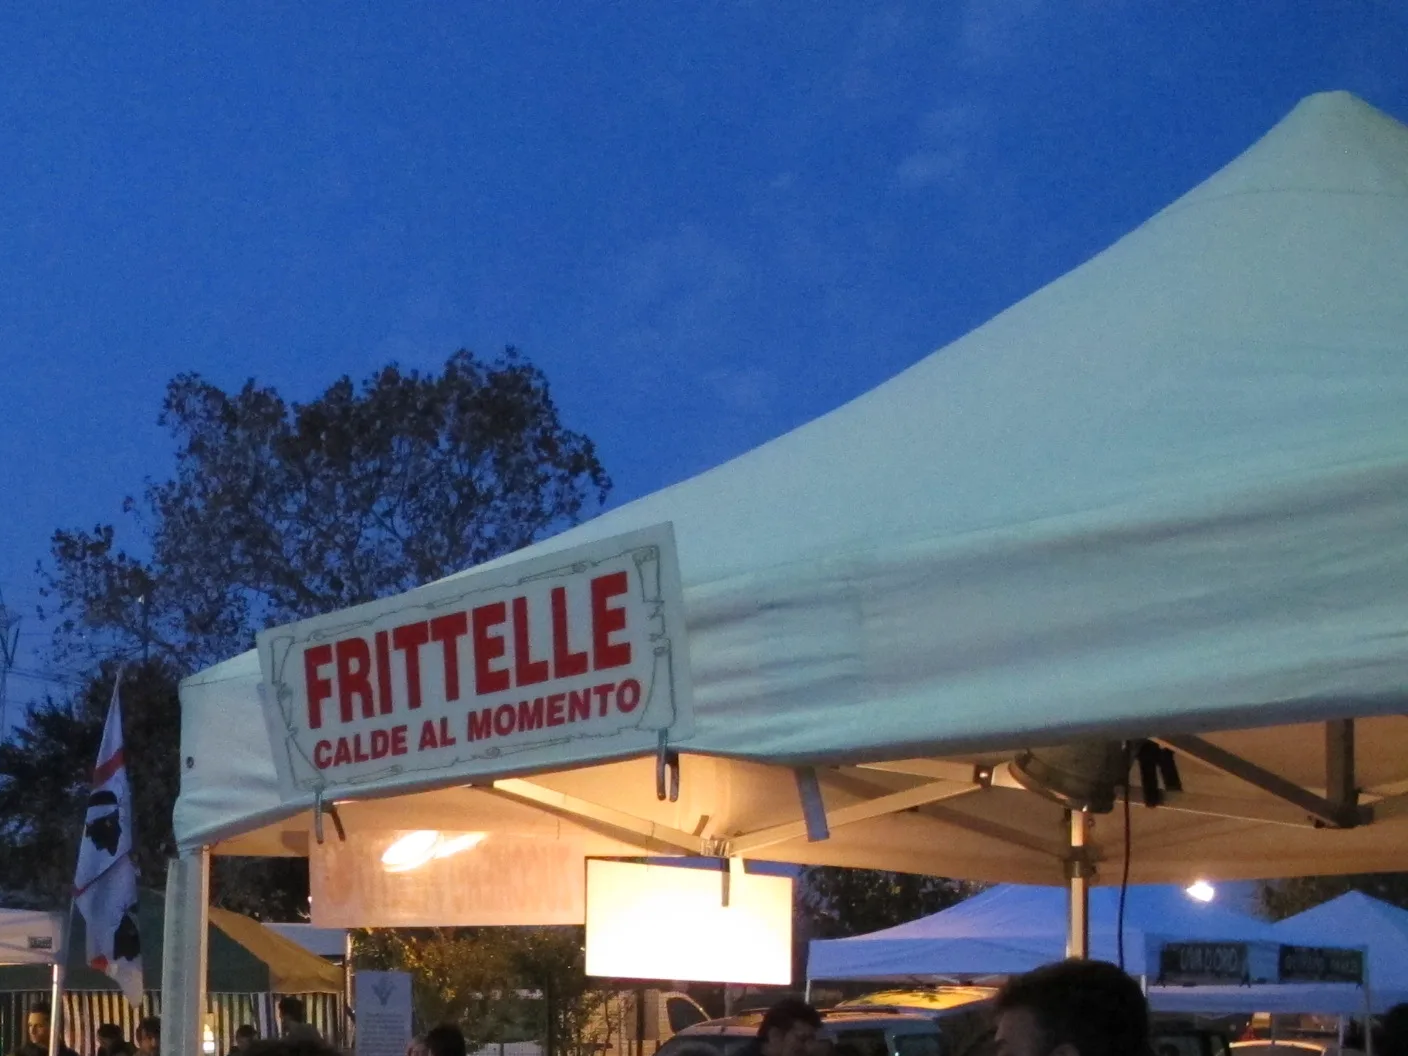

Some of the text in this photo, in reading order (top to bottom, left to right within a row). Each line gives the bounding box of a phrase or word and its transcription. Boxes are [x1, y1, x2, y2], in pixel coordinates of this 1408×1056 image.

[304, 571, 631, 729] FRITTELLE
[313, 678, 641, 770] CALDE AL MOMENTO
